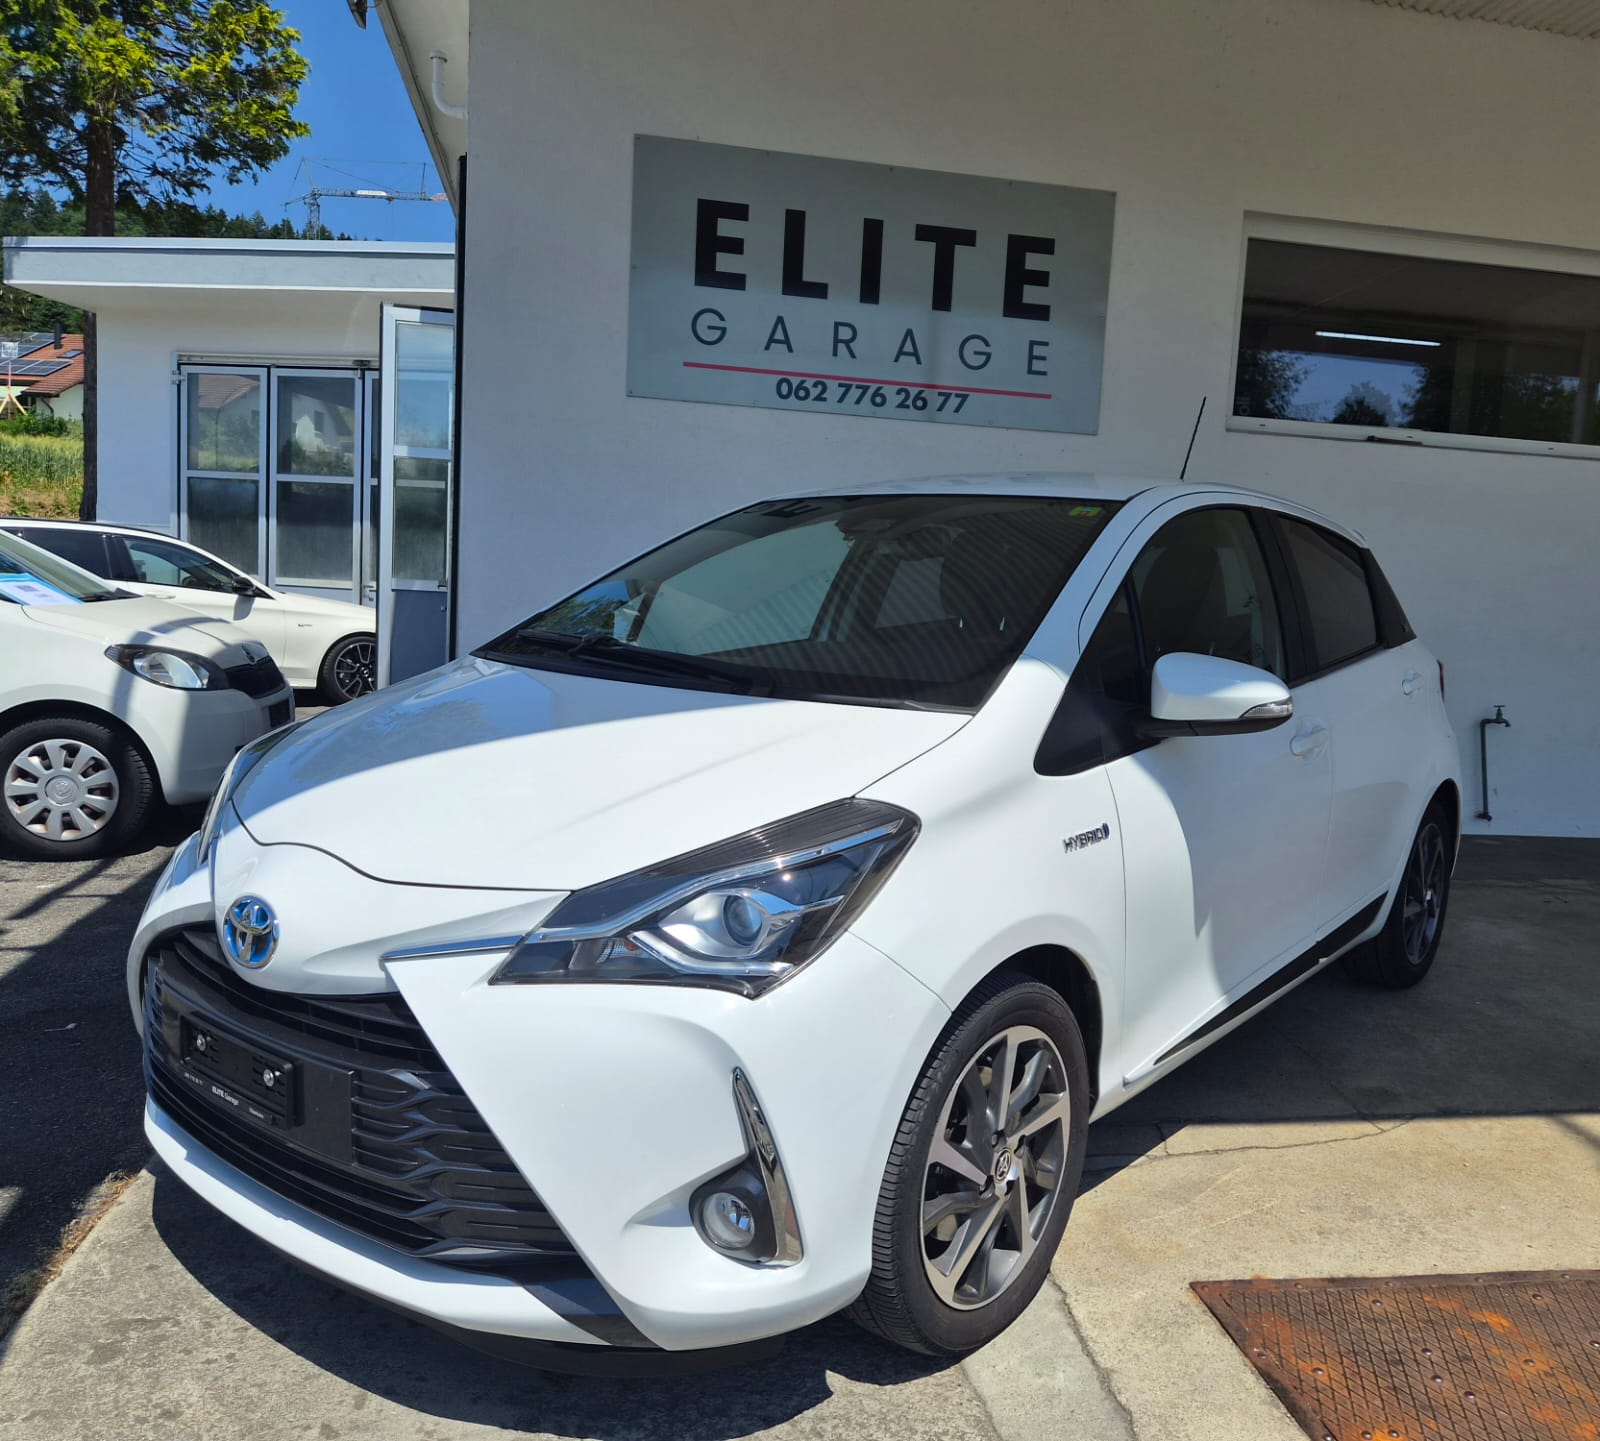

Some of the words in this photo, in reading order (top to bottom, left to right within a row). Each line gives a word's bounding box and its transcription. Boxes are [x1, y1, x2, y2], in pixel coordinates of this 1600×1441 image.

[694, 198, 1056, 321] ELITE
[691, 308, 1050, 376] GARAGE
[775, 377, 828, 403] 062
[836, 381, 888, 408] 776
[895, 387, 929, 412] 26
[936, 391, 970, 414] 77
[1063, 827, 1104, 853] HYBRID
